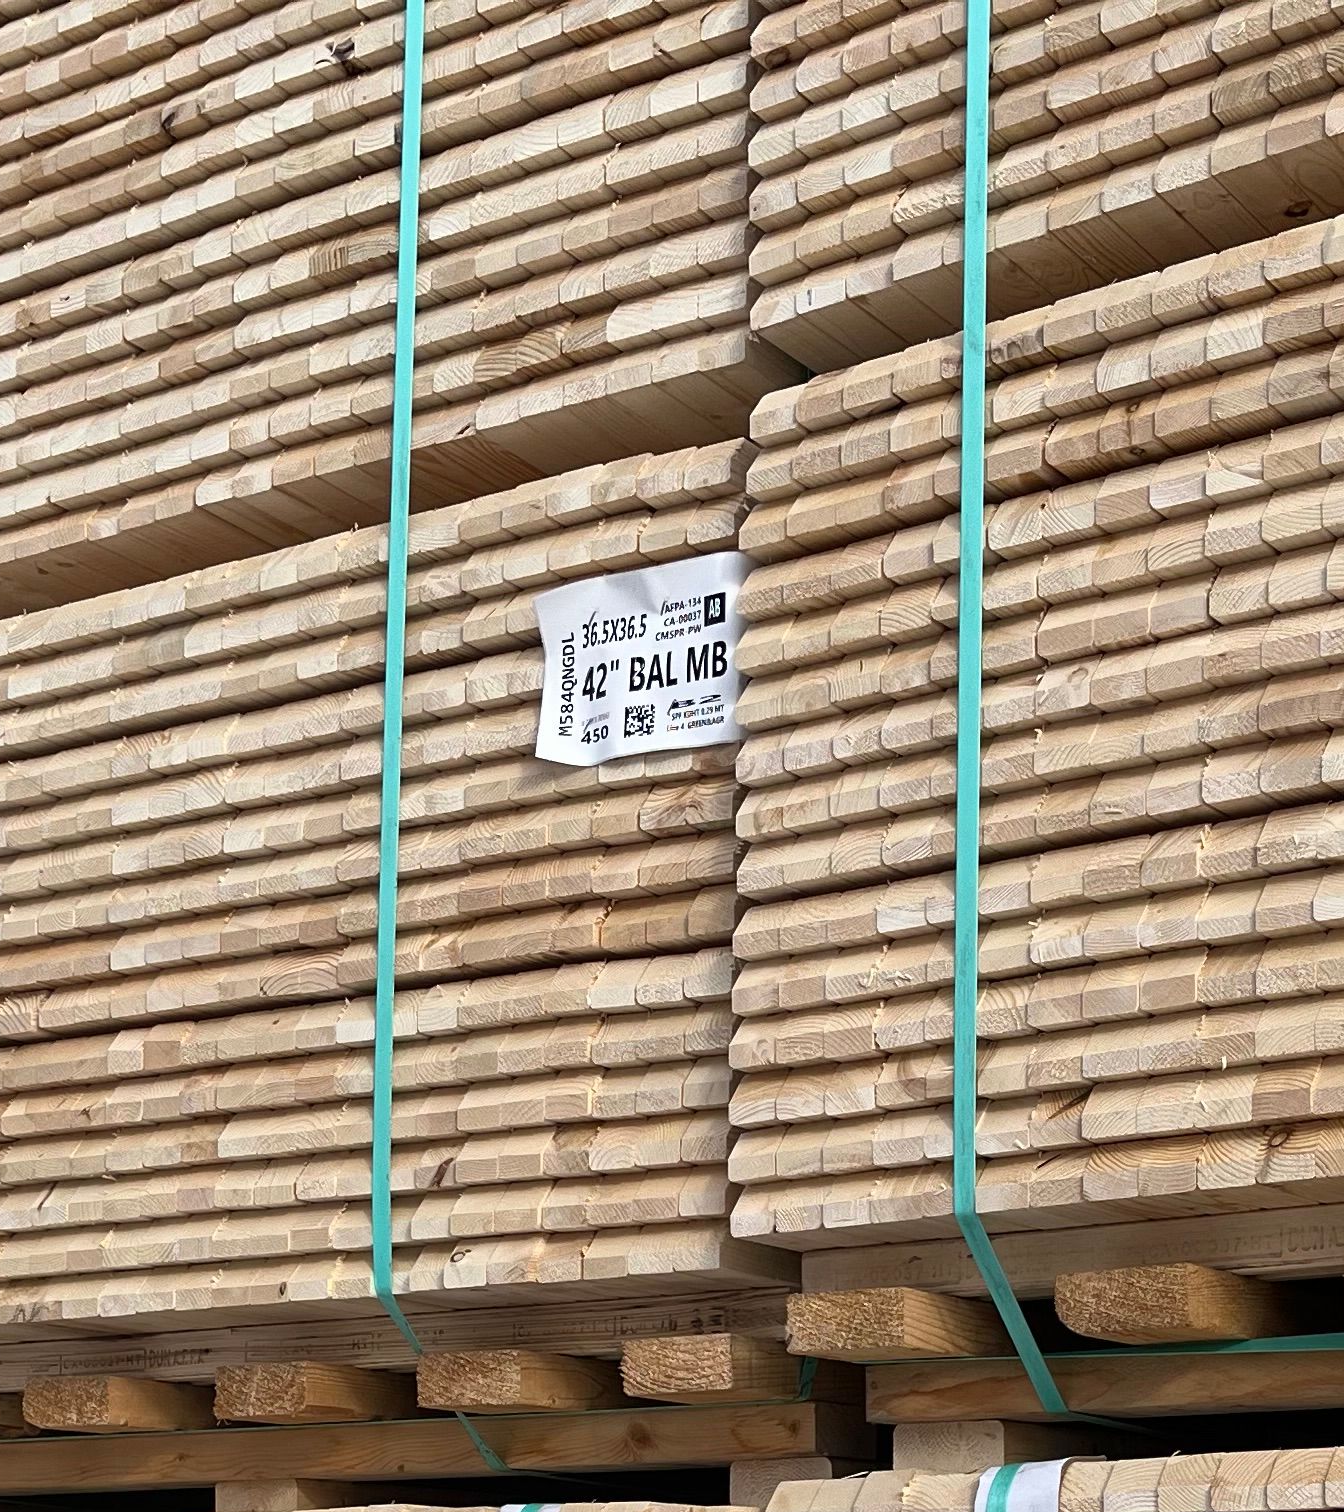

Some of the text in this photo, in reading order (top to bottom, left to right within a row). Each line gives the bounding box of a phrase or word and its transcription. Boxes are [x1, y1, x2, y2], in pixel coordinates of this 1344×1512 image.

[664, 597, 702, 613] AFPA-134
[664, 611, 702, 627] CA-00037
[582, 614, 647, 649] 36.5X36.5
[582, 640, 729, 702] 42" BAL MB
[581, 725, 609, 744] 450
